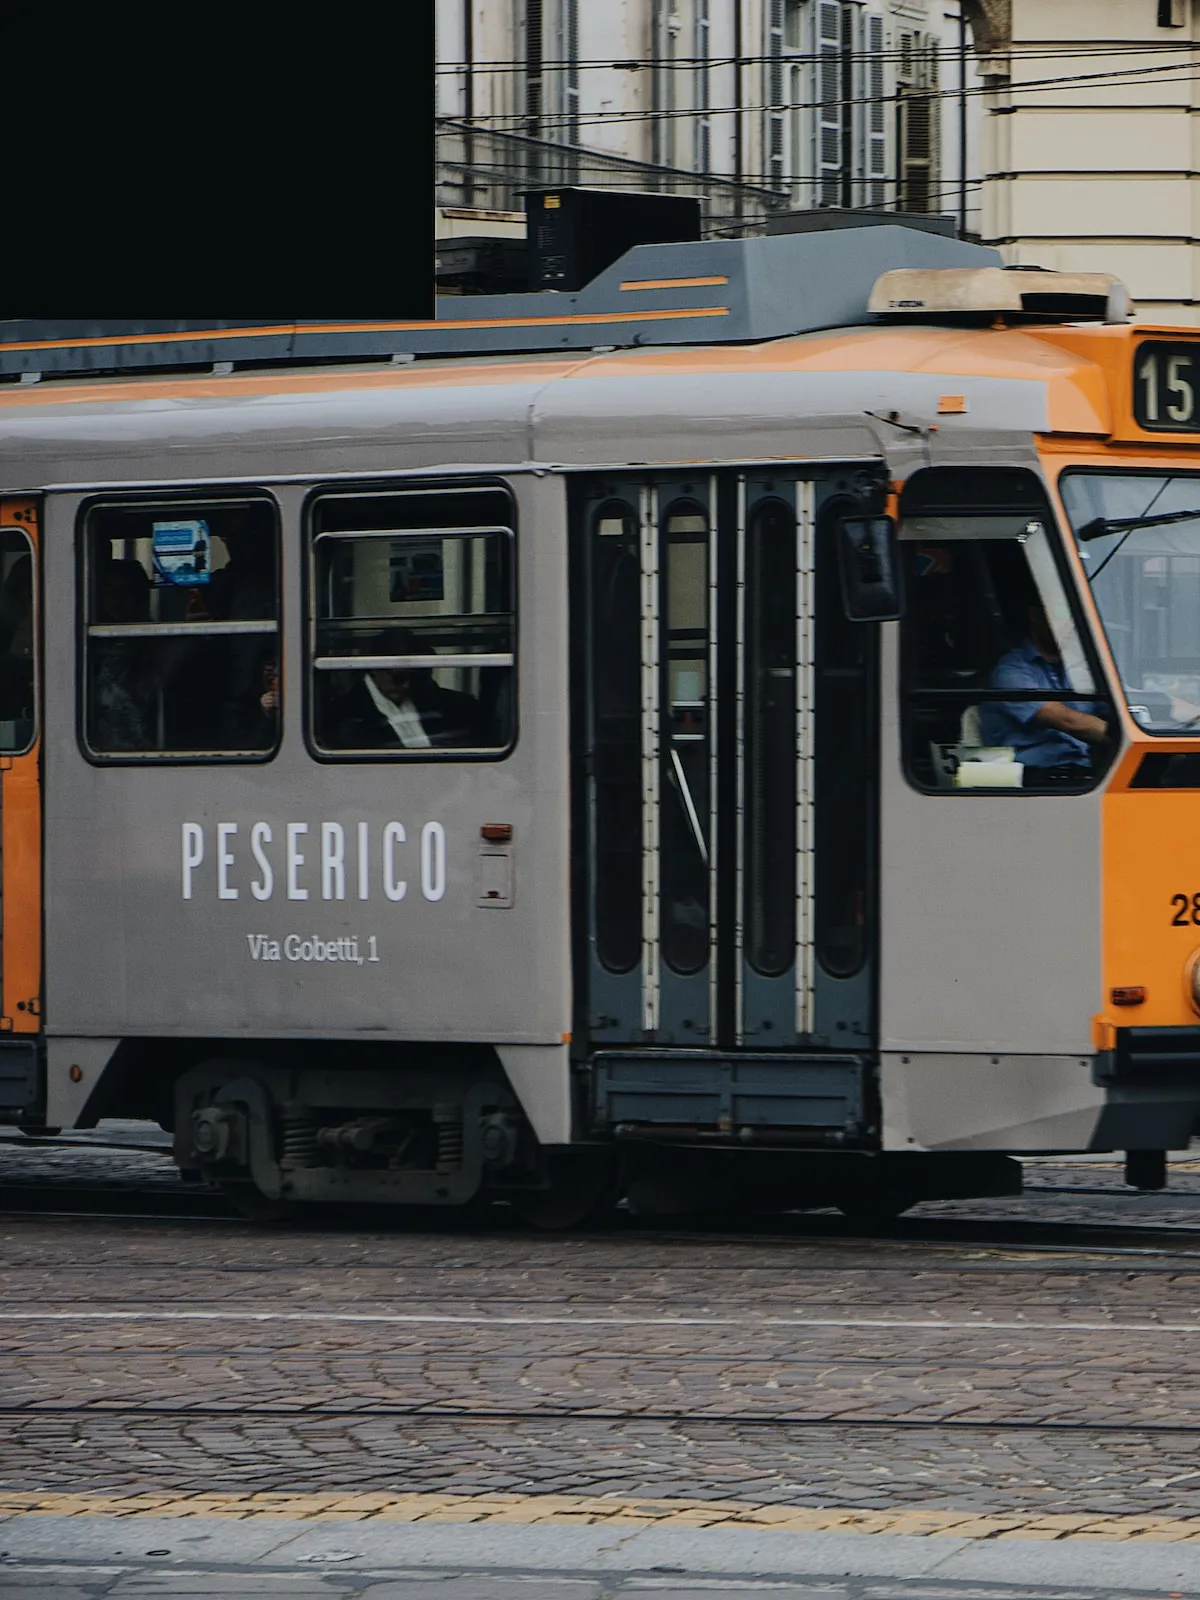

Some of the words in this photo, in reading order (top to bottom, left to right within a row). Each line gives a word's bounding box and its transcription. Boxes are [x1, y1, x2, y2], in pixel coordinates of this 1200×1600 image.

[1140, 354, 1194, 422] 15
[181, 821, 447, 901] PESERICO
[246, 933, 281, 961] Via
[283, 933, 364, 966] Gobetti,
[367, 935, 380, 962] 1
